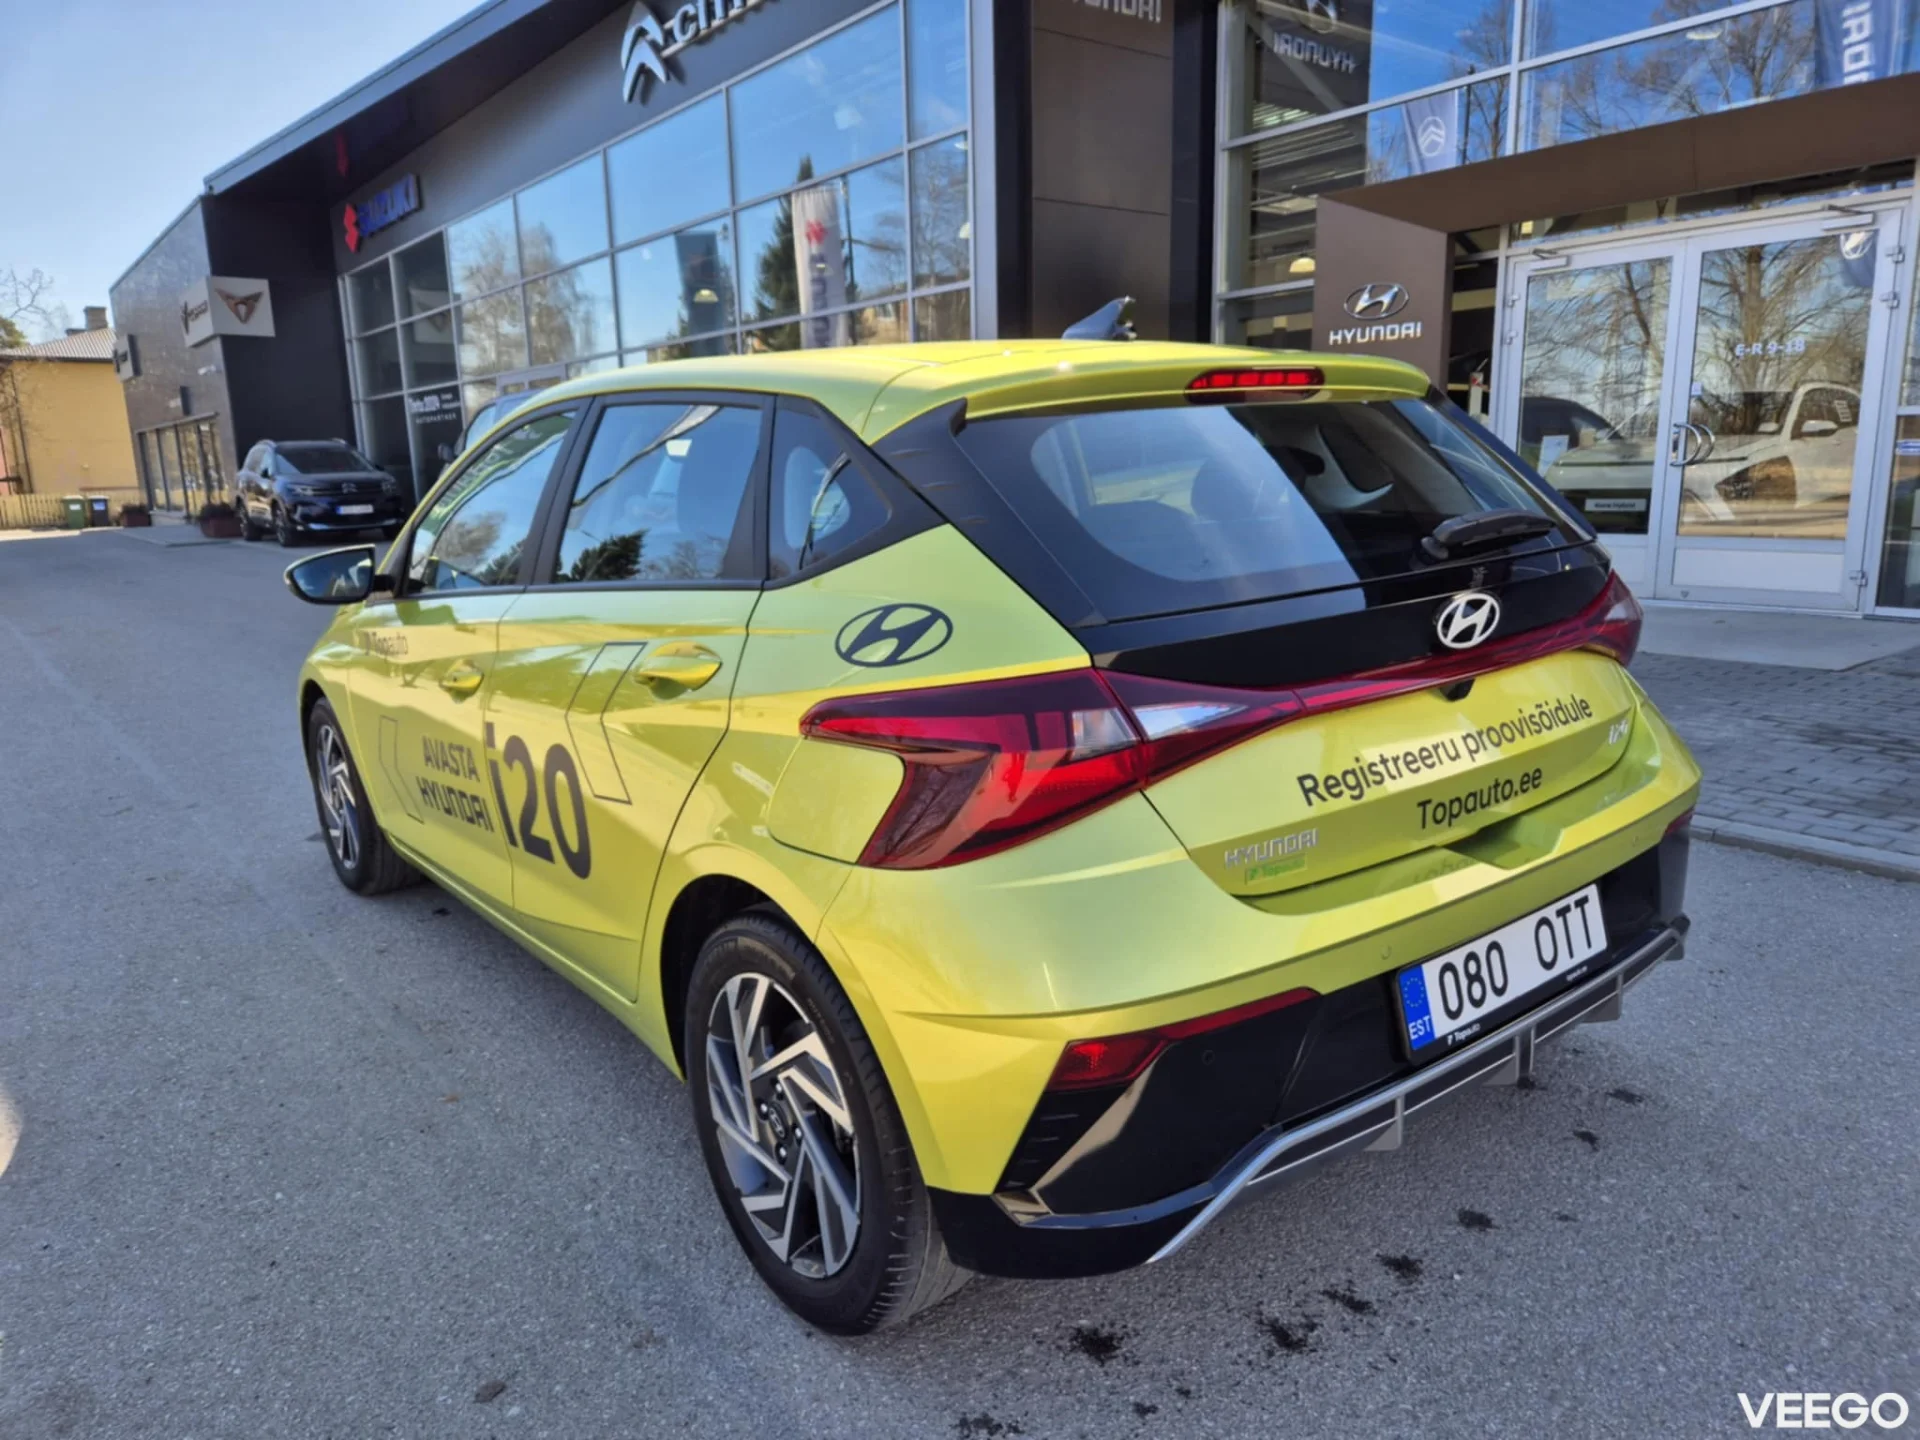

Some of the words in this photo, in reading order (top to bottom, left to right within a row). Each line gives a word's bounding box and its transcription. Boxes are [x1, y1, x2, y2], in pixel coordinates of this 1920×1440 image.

[1328, 321, 1422, 346] HYUNDAI
[422, 735, 481, 783] AVASTA
[1297, 735, 1461, 806] Registreeru
[1460, 694, 1593, 763] proovisõidule
[415, 775, 495, 833] HYUNDAI
[484, 721, 592, 880] i20
[1417, 766, 1542, 829] Topauto.ee
[1224, 828, 1318, 870] HYUNDAI
[1438, 940, 1508, 1021] 080
[1534, 894, 1592, 971] OTT
[1409, 1015, 1431, 1040] EST
